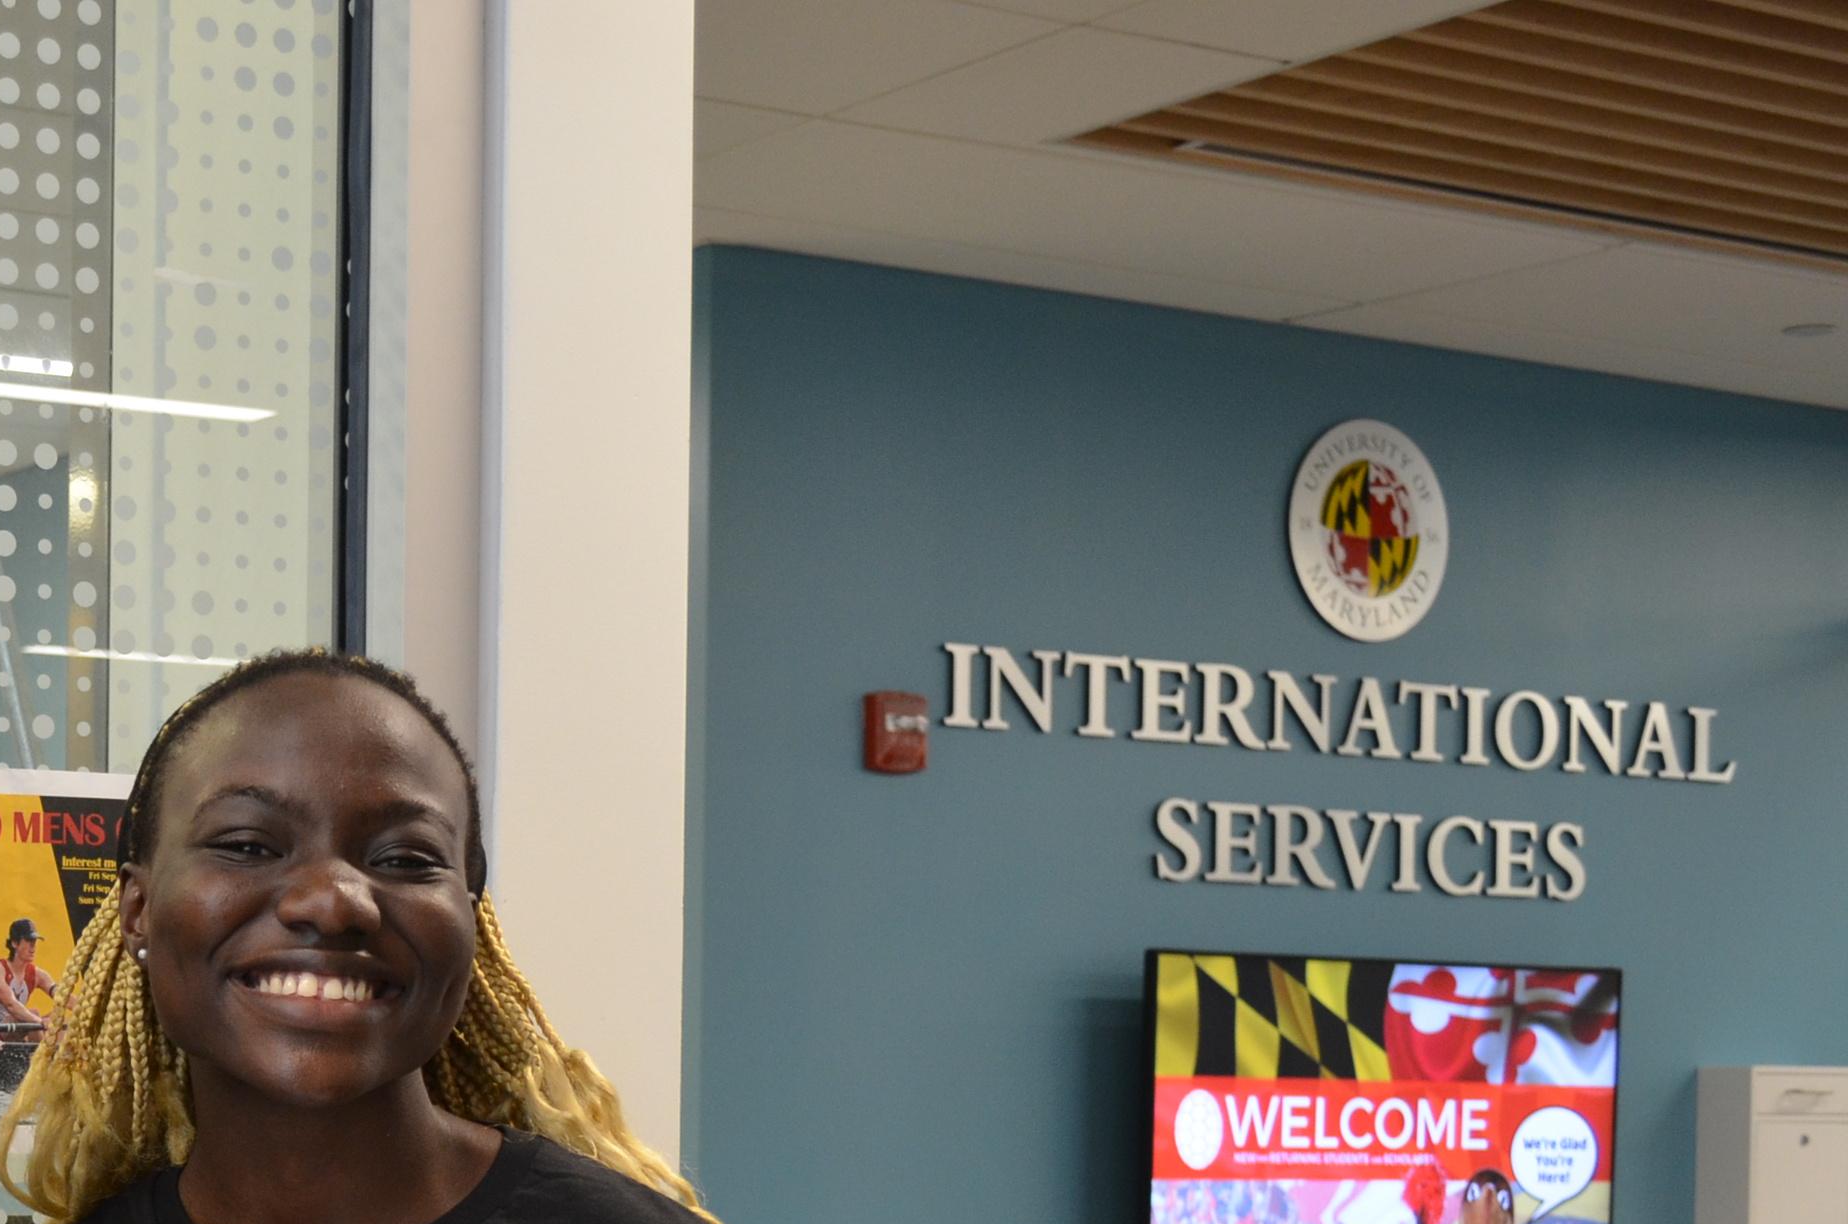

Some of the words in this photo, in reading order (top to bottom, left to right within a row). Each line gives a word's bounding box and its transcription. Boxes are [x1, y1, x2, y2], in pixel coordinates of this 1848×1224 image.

[1305, 432, 1413, 492] UNIVERSITY
[1412, 473, 1434, 504] OF
[1307, 562, 1431, 628] MARYLAND
[943, 642, 1738, 784] INTERNATIONAL
[13, 811, 105, 846] MENS
[1154, 797, 1587, 901] SERVICES
[62, 856, 101, 868] Interest
[1224, 1094, 1490, 1150] WELCOME
[1560, 1136, 1586, 1149] Glad
[1536, 1155, 1573, 1167] You're
